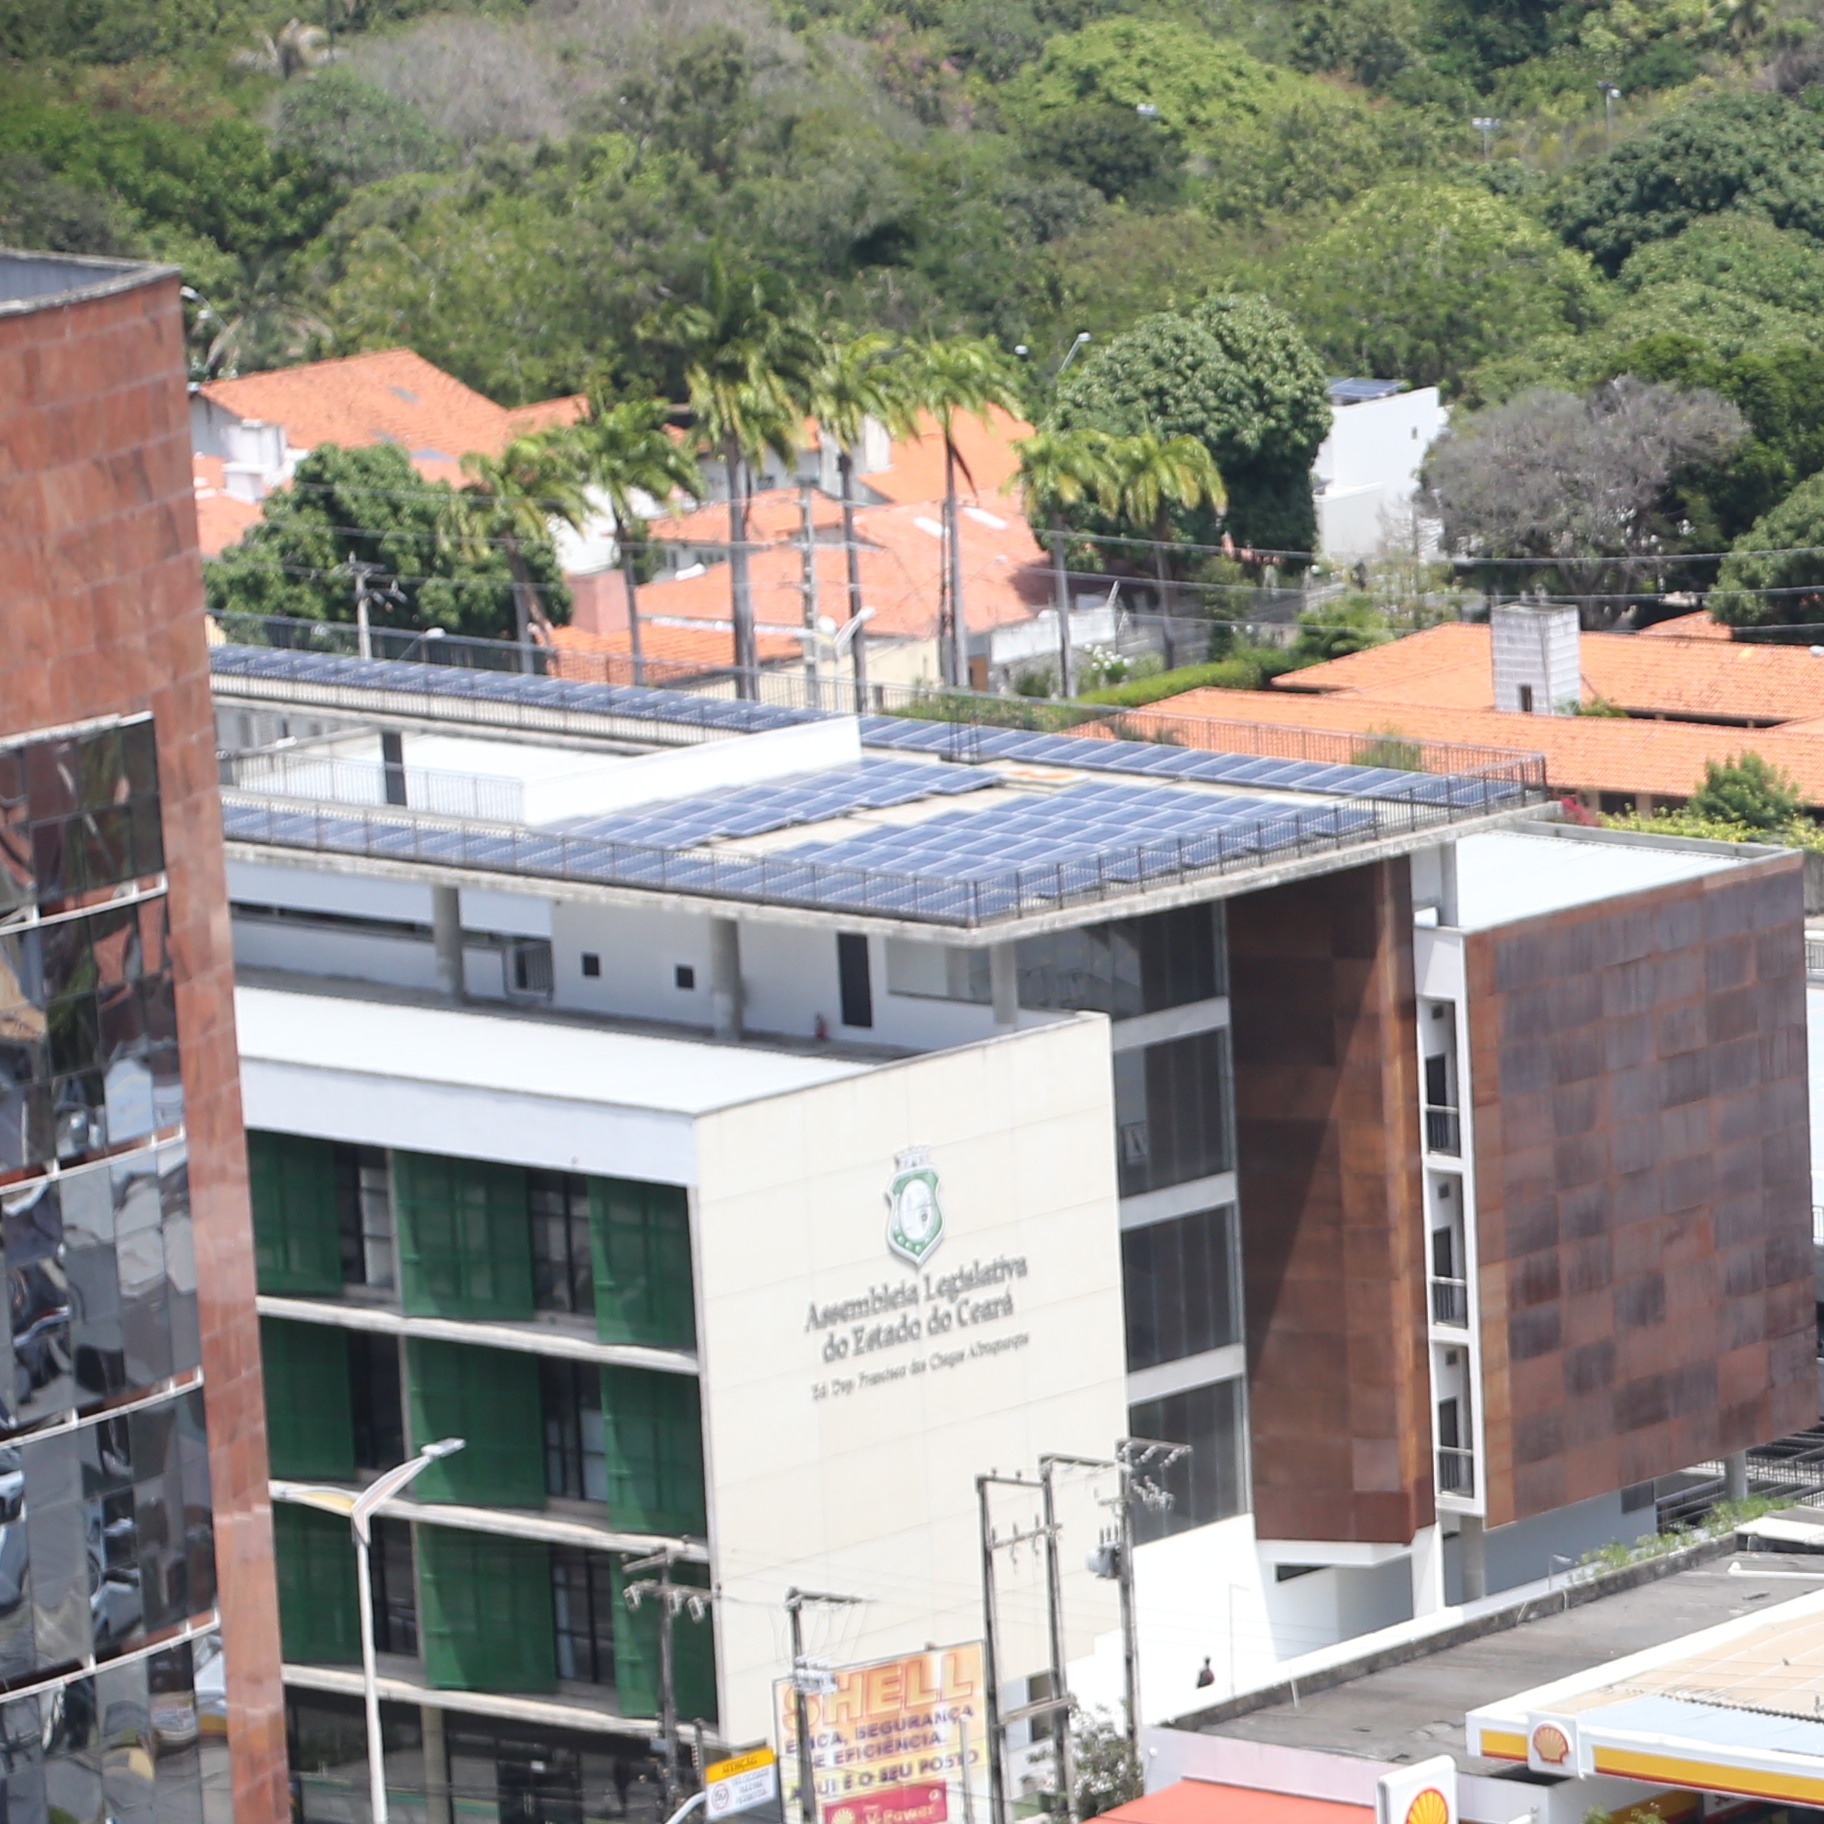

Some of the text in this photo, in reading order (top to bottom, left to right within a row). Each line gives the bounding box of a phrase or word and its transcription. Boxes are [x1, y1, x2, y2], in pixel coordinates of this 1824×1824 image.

[804, 1254, 1028, 1333] Assembleia Legislativa
[822, 1285, 1014, 1364] do Estado do Ceará
[790, 1777, 836, 1801] AUI
[879, 1764, 913, 1783] SEU
